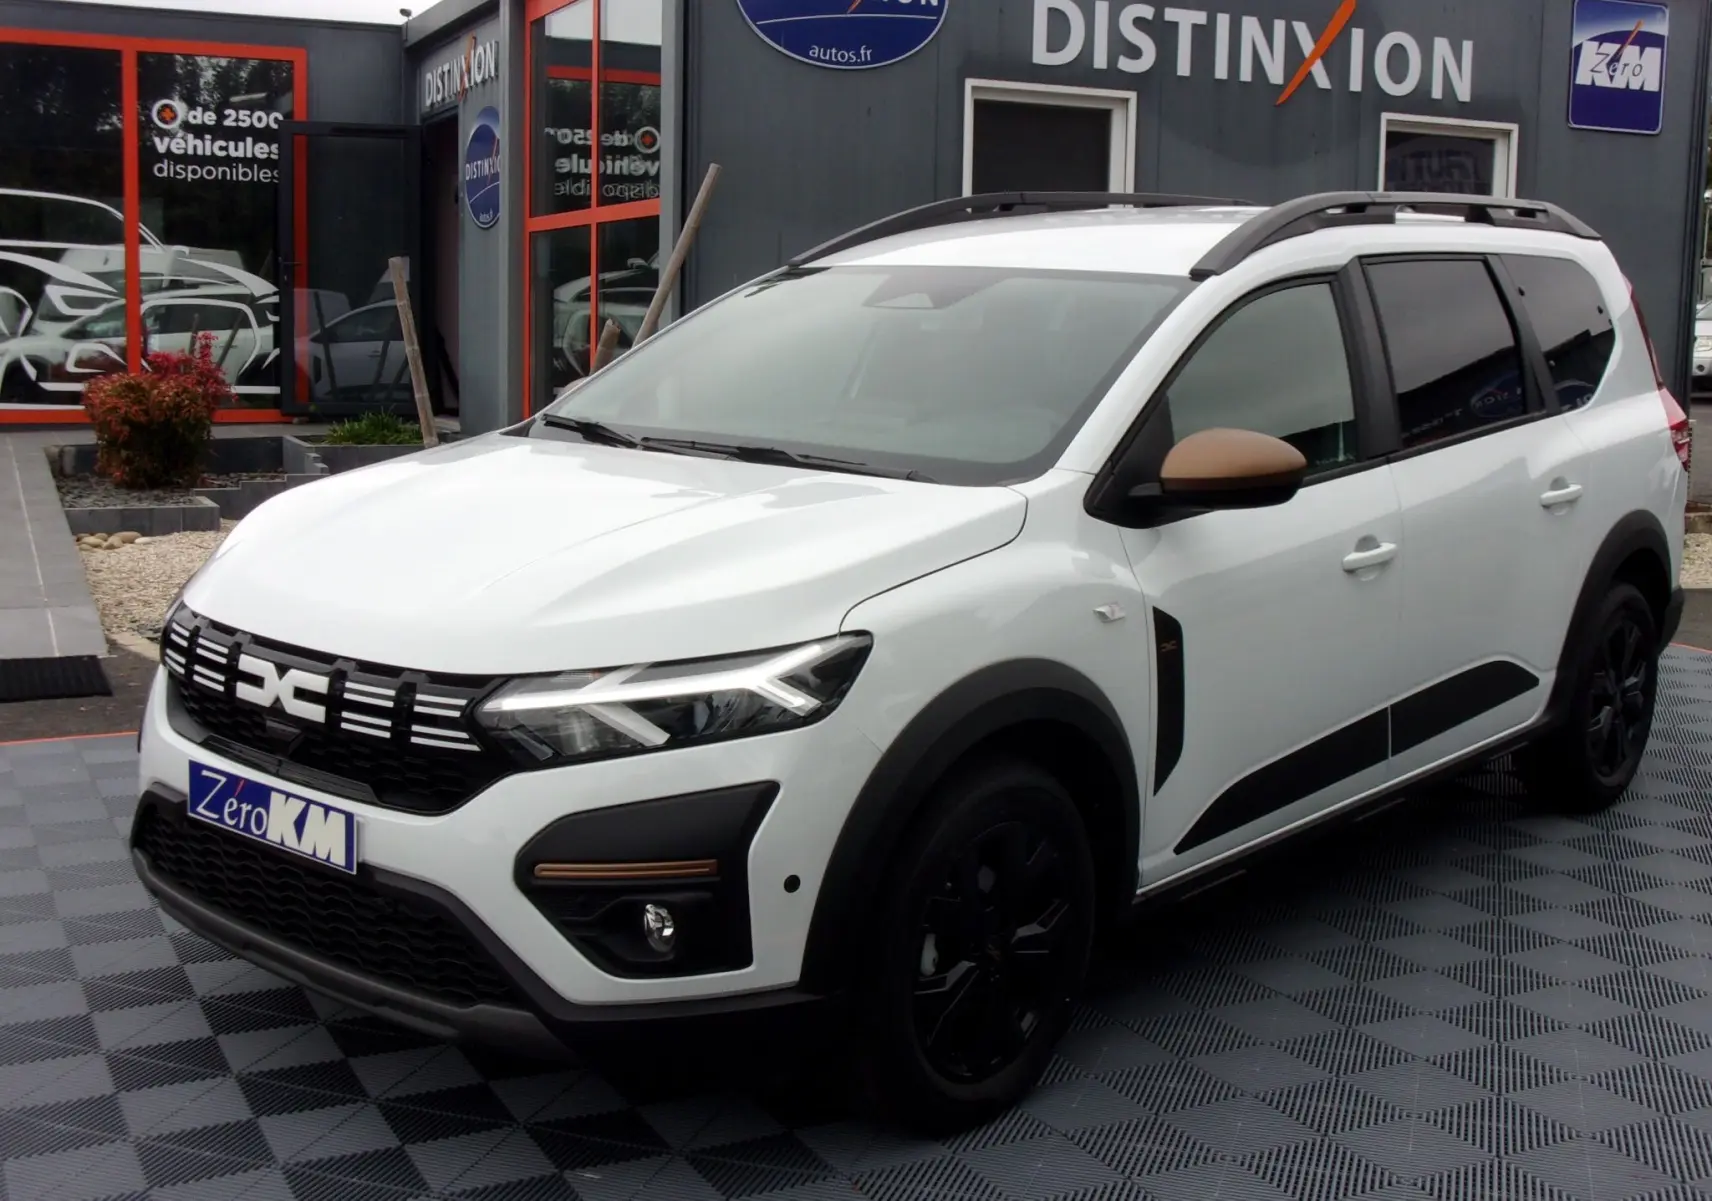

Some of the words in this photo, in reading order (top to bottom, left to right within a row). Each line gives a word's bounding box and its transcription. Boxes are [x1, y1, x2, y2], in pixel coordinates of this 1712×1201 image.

[425, 40, 496, 106] DISTINXION
[809, 45, 873, 63] autos.fr
[1032, 0, 1474, 104] DISTINXION
[1575, 40, 1662, 92] KM
[187, 106, 217, 125] de
